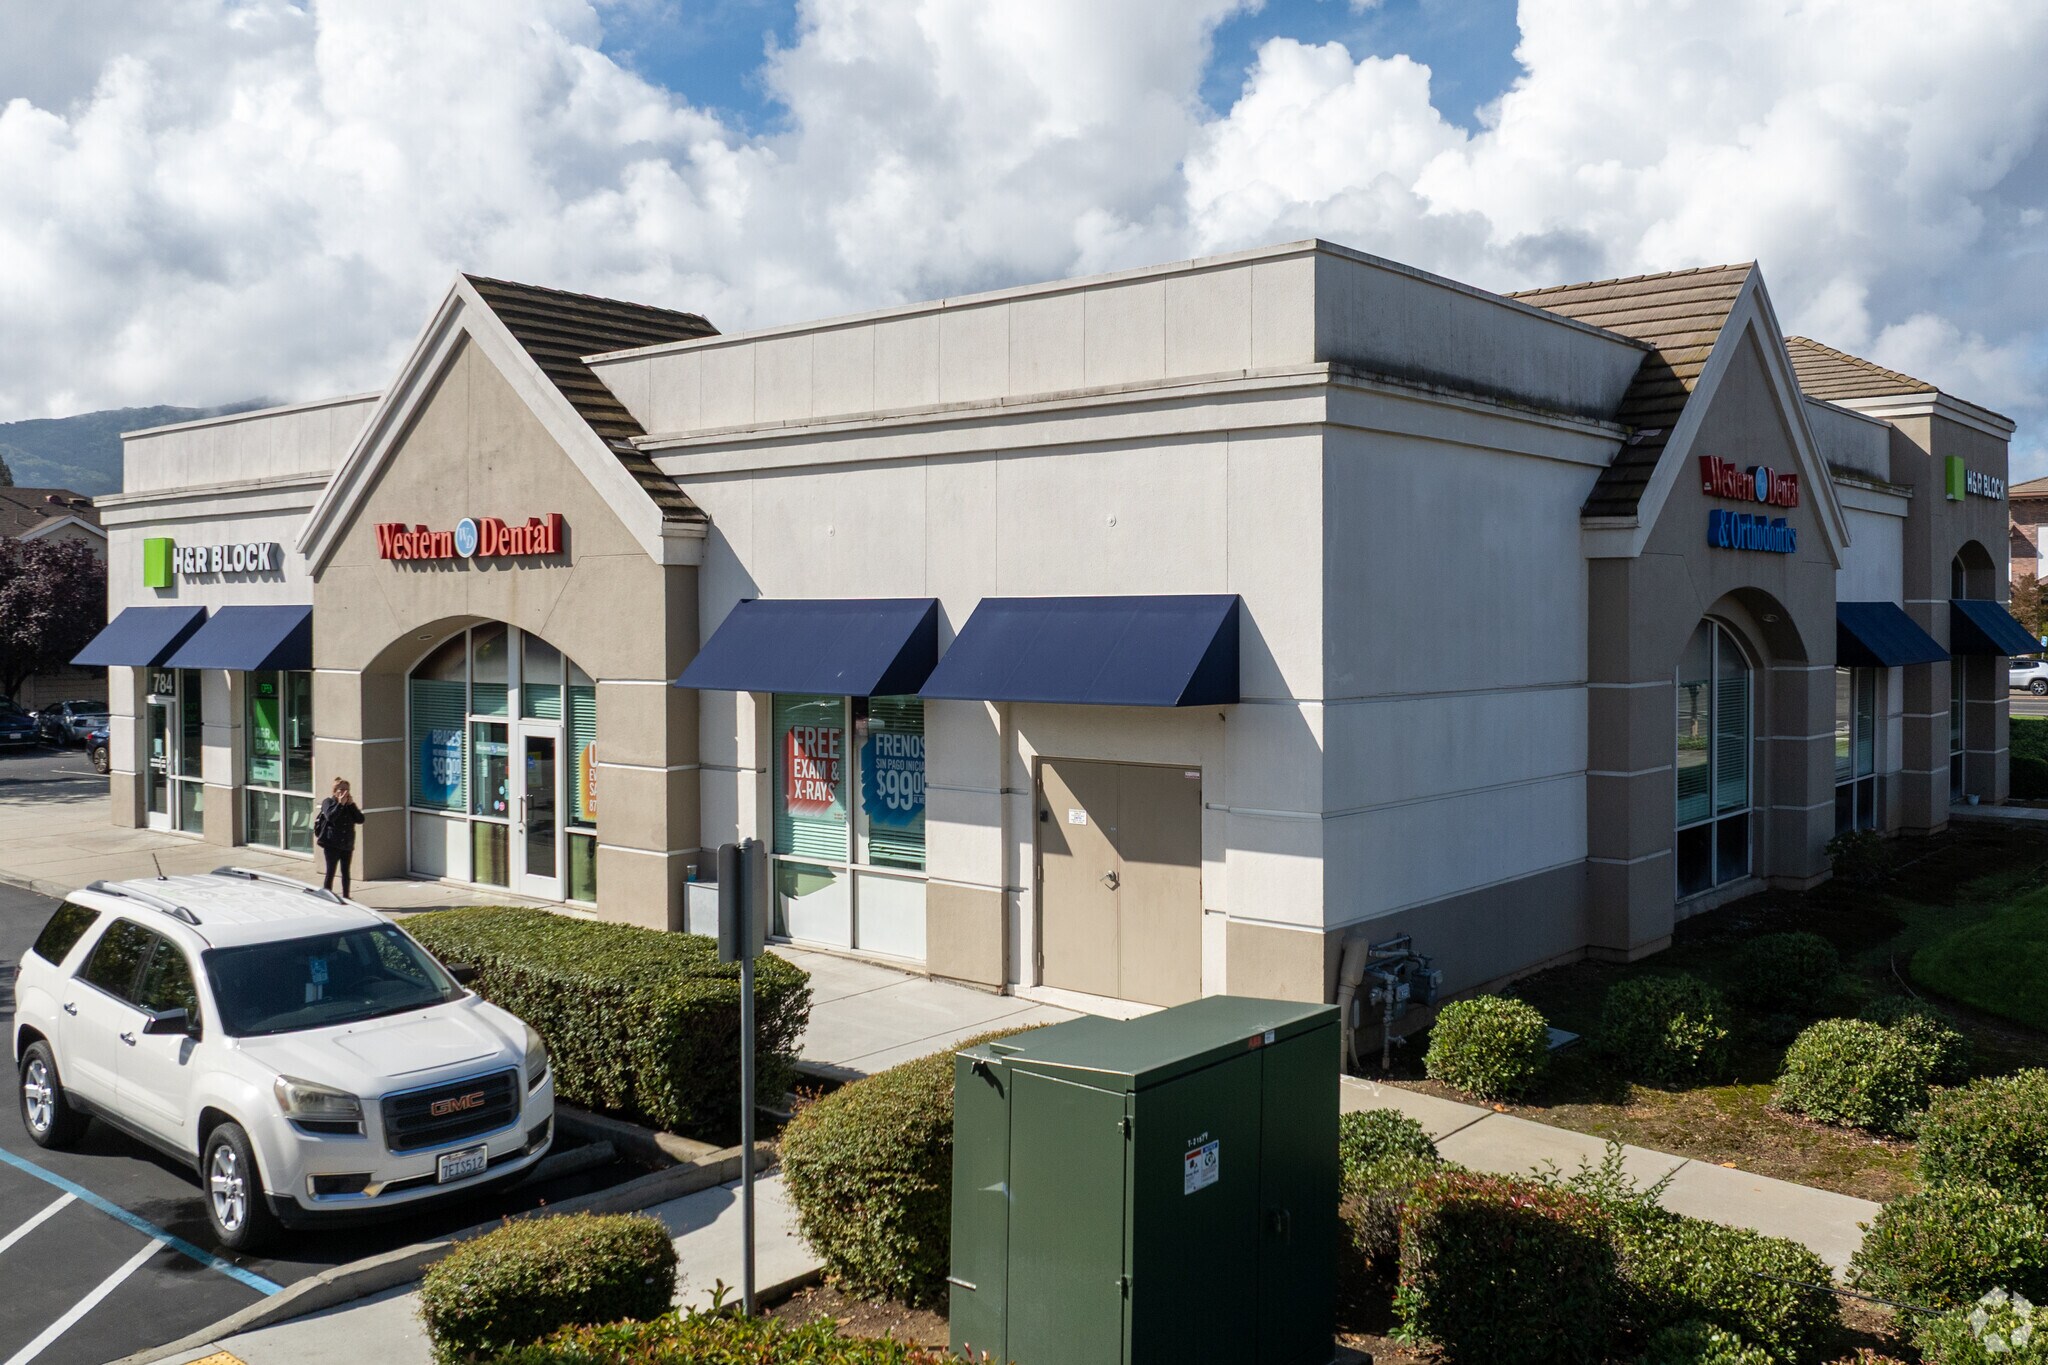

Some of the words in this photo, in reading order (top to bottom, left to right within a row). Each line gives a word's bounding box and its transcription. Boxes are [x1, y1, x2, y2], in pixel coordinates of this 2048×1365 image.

[1709, 455, 1755, 501] Western
[1967, 469, 1983, 495] H&R
[1983, 474, 2005, 501] BLOCK
[374, 523, 454, 560] Western
[478, 513, 556, 557] Dental
[1718, 509, 1729, 548] &
[1731, 511, 1797, 553] Orthodontics
[172, 546, 208, 574] H&R
[211, 542, 272, 573] BLOCK
[152, 673, 173, 694] 784
[255, 727, 271, 739] H&R
[432, 729, 463, 747] BRACES
[793, 726, 840, 759] FREE
[255, 739, 280, 752] BLOCK
[793, 758, 827, 780] EXAM
[831, 760, 840, 781] &
[875, 758, 887, 769] SIN
[888, 758, 905, 771] PAGO
[905, 760, 925, 773] INICIA
[794, 779, 836, 802] X-RAYS
[431, 1091, 485, 1116] GMC
[442, 1156, 484, 1178] 7EIS512
